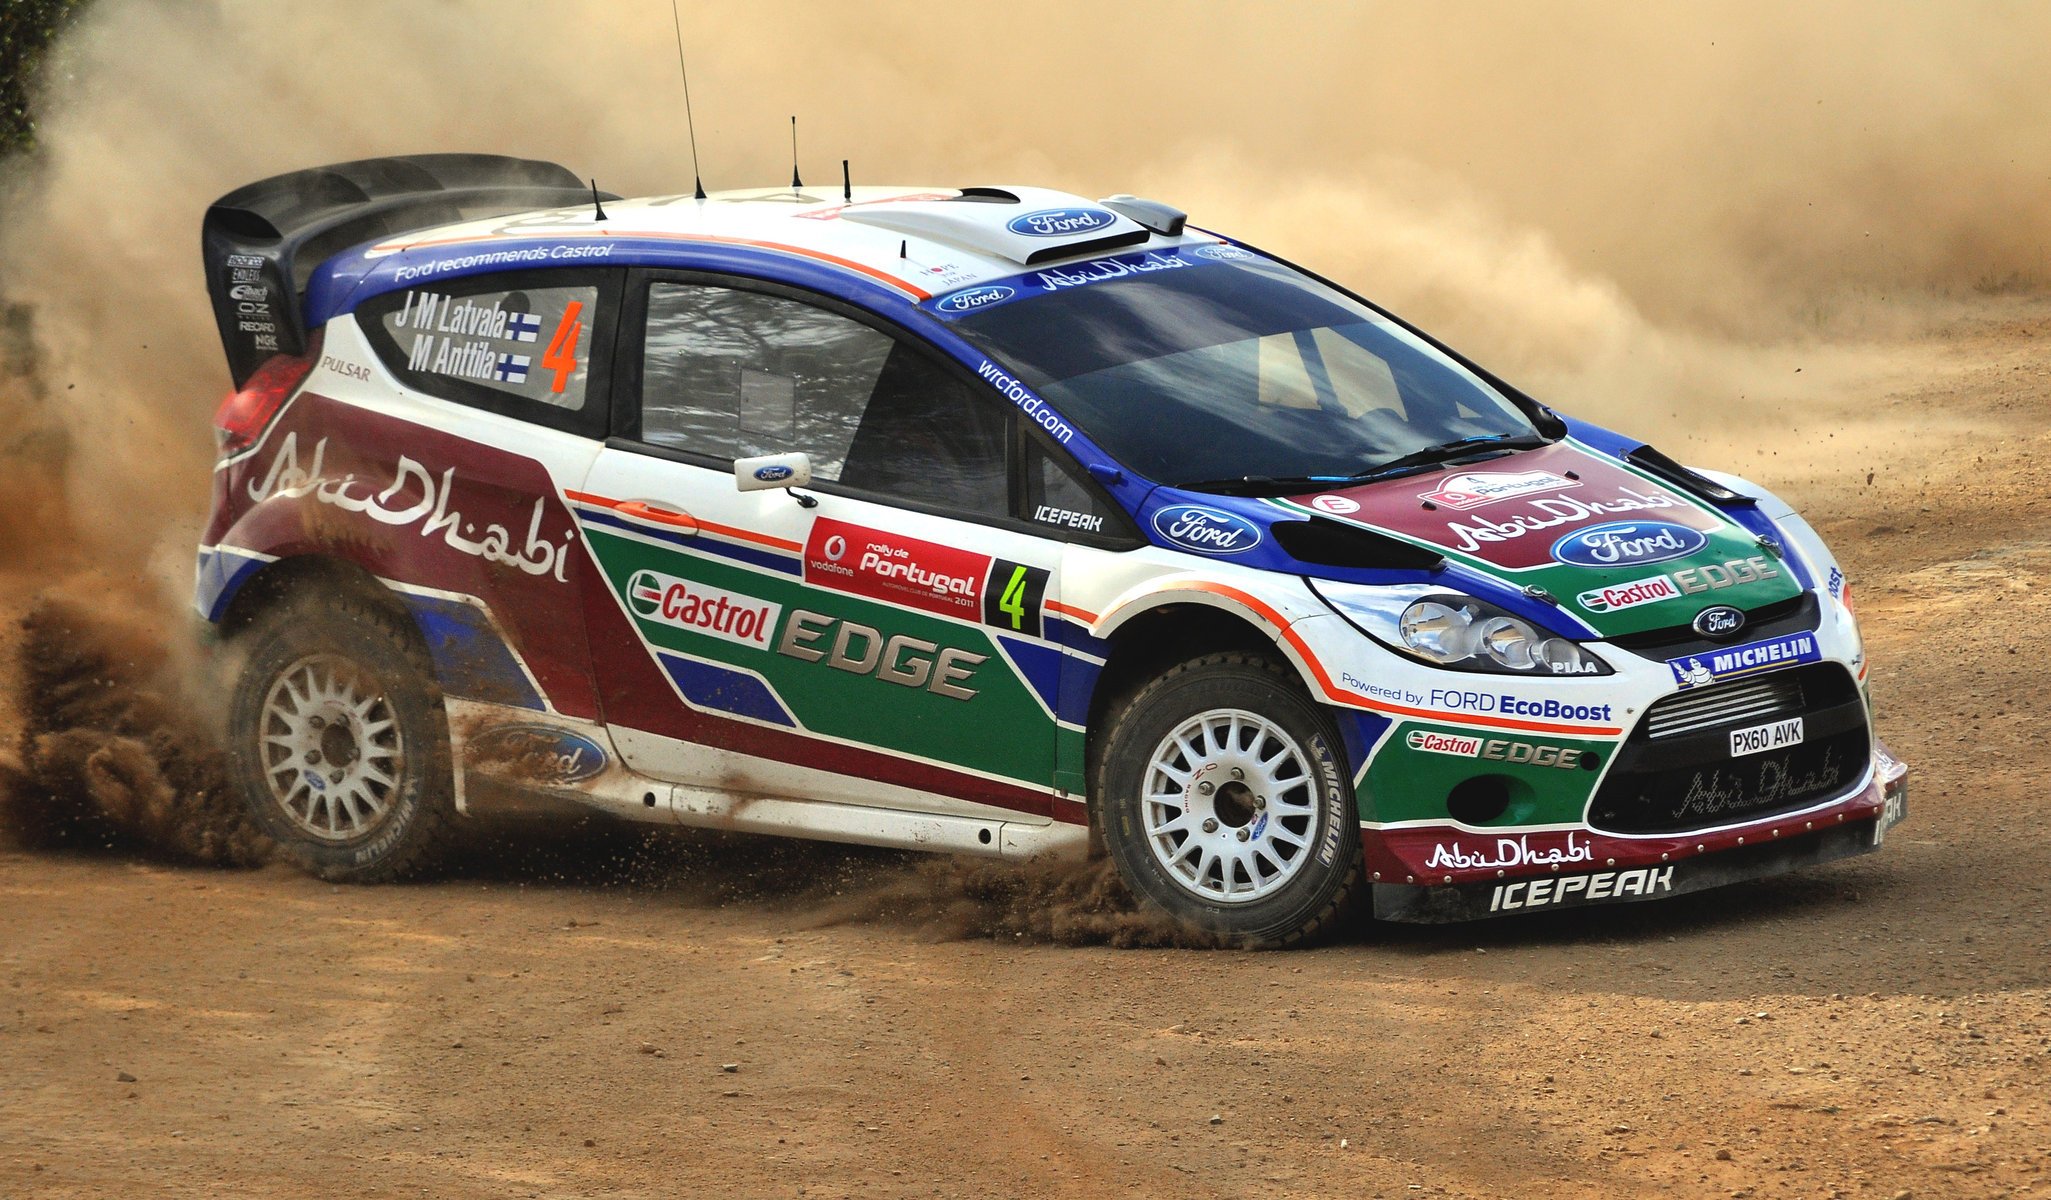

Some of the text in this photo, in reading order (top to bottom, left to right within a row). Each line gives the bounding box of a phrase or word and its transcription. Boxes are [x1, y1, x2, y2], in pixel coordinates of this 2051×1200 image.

[1027, 212, 1100, 233] Ford
[394, 243, 614, 282] Ford recommends Castrol
[394, 290, 508, 339] J M Latvala
[952, 286, 1005, 310] Ford
[407, 334, 497, 380] M Anttila
[541, 301, 584, 394] 4
[321, 355, 371, 382] PULSAR
[978, 360, 1074, 444] wrcford.com
[1034, 505, 1104, 532] ICEPEAK
[1170, 509, 1245, 548] Ford
[866, 543, 910, 559] rally de
[1581, 526, 1686, 562] Ford
[811, 560, 854, 578] vodafone
[859, 552, 976, 597] Portugal
[1604, 556, 1779, 609] Castrol EDGE
[954, 596, 974, 608] 2011
[999, 565, 1027, 630] 4
[1708, 611, 1737, 632] Ford
[662, 583, 992, 701] Castrol EDGE
[1713, 637, 1813, 673] MICHELIN
[1551, 661, 1598, 674] PIAA
[1342, 672, 1612, 722] Powered by FORD EcoBoost
[1423, 734, 1584, 770] Castrol EDGE
[1733, 720, 1801, 754] PX60 AVK
[1321, 761, 1342, 864] MICHELIN
[1489, 865, 1675, 912] ICEPEAK
